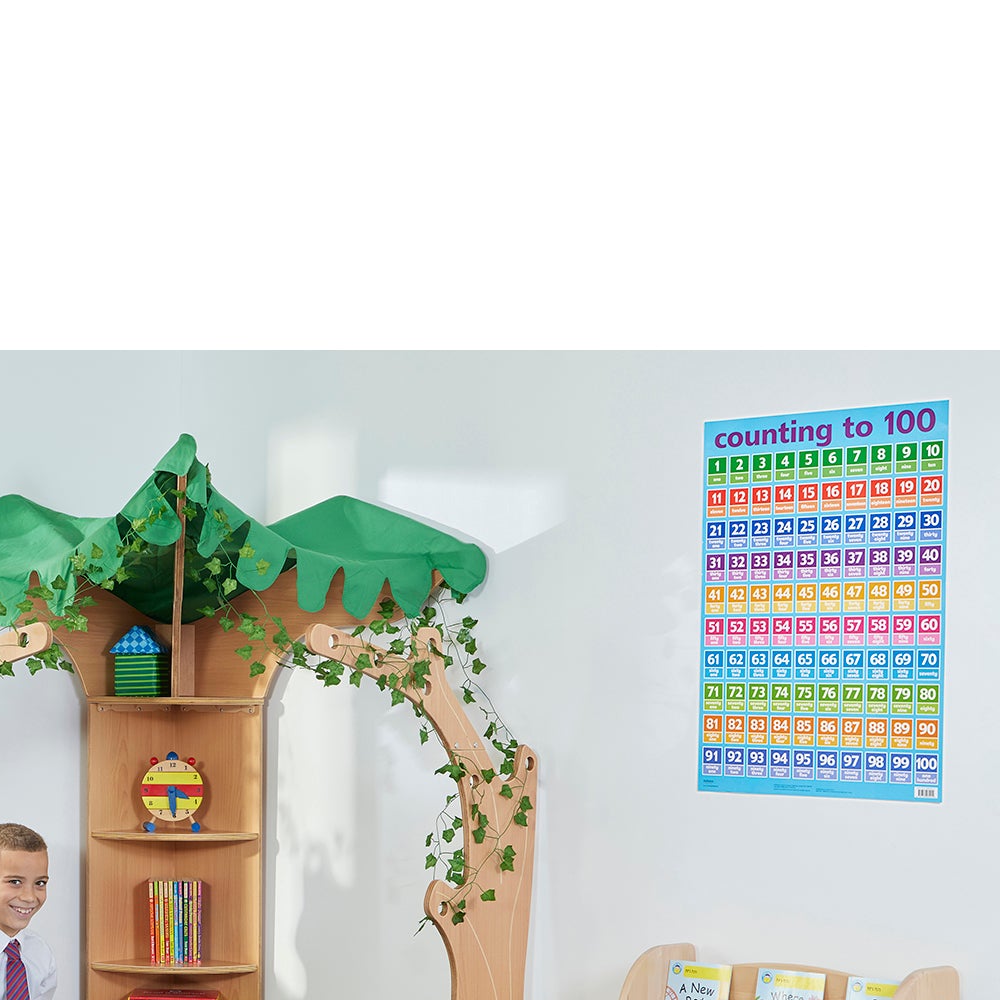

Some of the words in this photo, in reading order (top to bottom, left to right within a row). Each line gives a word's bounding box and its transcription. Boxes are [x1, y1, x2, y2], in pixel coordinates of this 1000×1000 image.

[715, 420, 832, 448] counting
[842, 416, 873, 438] to
[884, 408, 936, 435] 100
[715, 461, 719, 471] 1
[736, 459, 743, 470] 2
[759, 457, 766, 468] 3
[781, 455, 789, 466] 4
[805, 454, 812, 465] 5
[828, 452, 836, 463] 6
[853, 450, 861, 462] 7
[877, 448, 886, 460] 8
[902, 446, 911, 458] 9
[926, 444, 940, 456] 10
[712, 492, 721, 504] 11
[734, 491, 746, 503] 12
[756, 490, 768, 501] 13
[779, 488, 792, 500] 14
[802, 487, 815, 499] 15
[826, 485, 840, 497] 16
[850, 484, 864, 496] 17
[875, 482, 888, 494] 18
[900, 480, 914, 493] 19
[924, 479, 940, 492] 20
[705, 750, 718, 762] 91
[727, 751, 742, 762] 92
[750, 752, 764, 763] 93
[772, 752, 788, 764] 94
[796, 753, 810, 765] 95
[820, 754, 835, 766] 96
[844, 755, 859, 767] 97
[868, 756, 884, 768] 98
[893, 756, 910, 768] 99
[916, 757, 937, 770] 100
[679, 984, 686, 993] A
[690, 982, 715, 996] New
